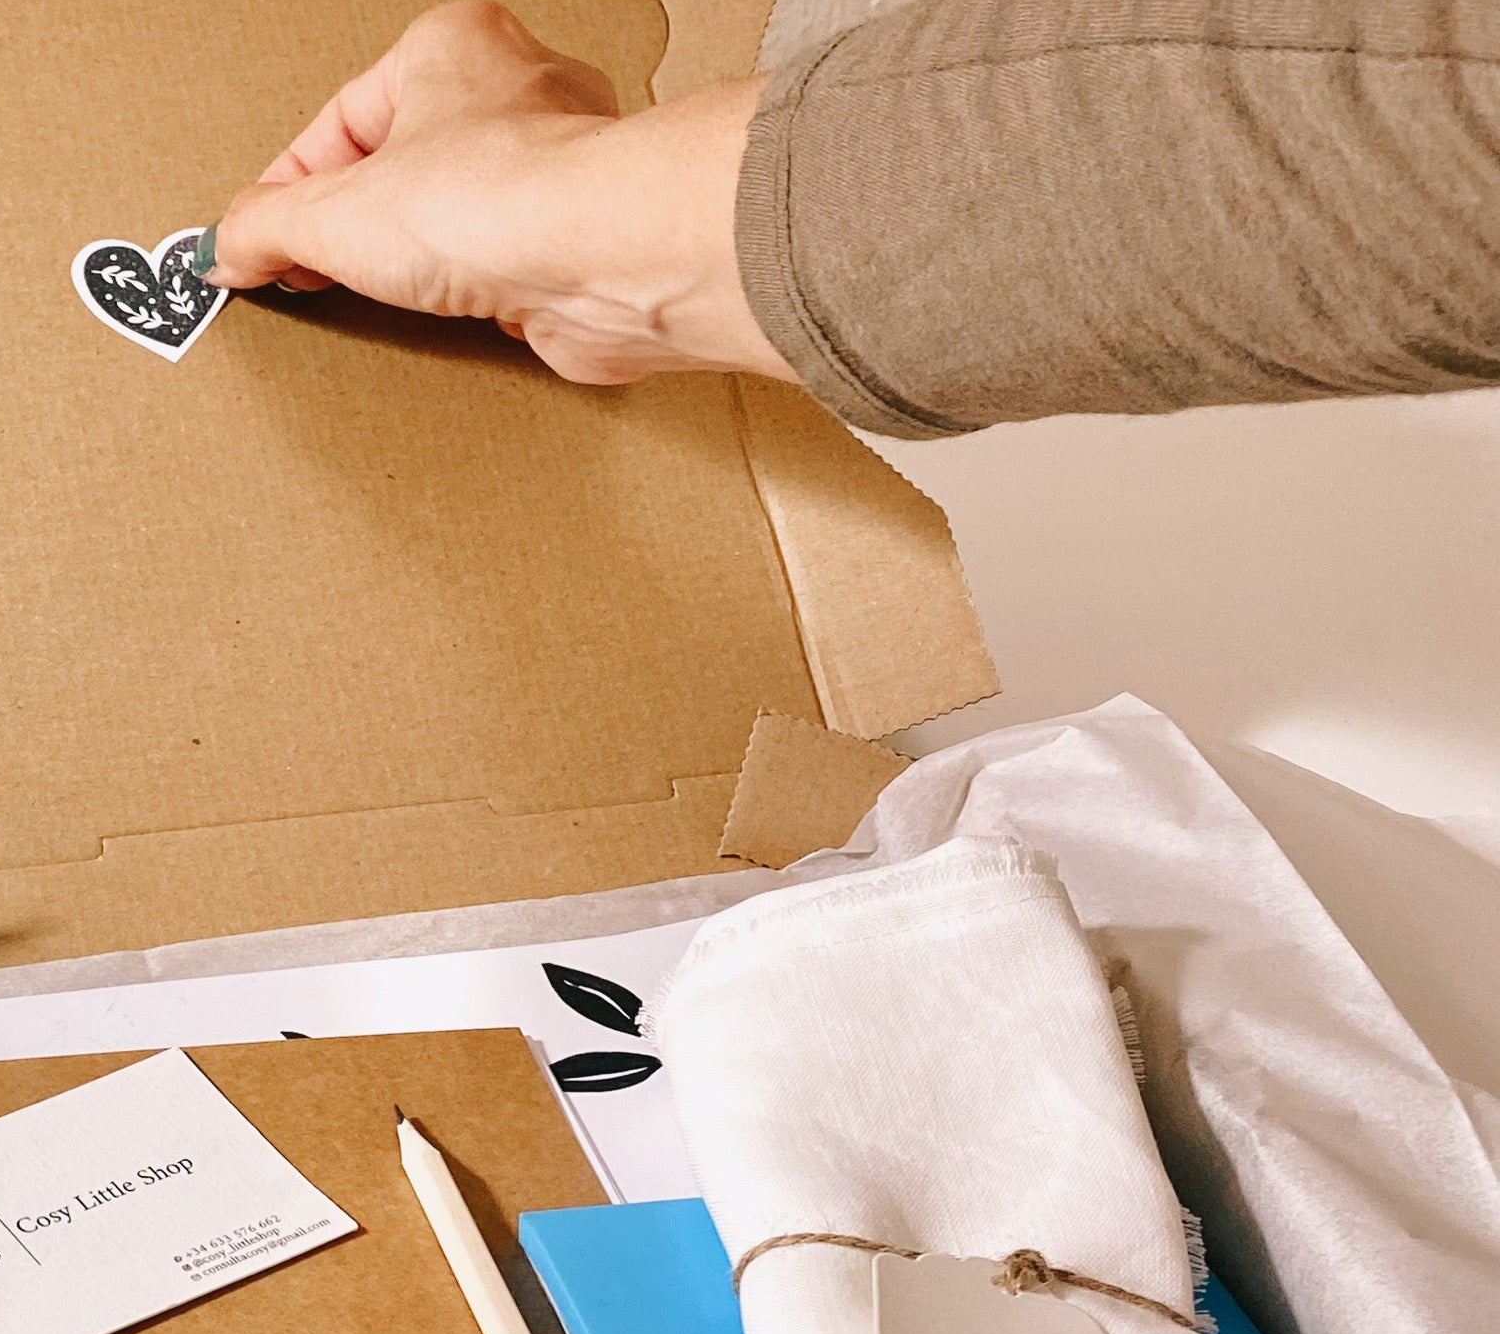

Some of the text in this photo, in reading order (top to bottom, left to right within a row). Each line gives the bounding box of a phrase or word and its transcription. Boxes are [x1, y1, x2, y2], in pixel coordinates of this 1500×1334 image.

[16, 1204, 73, 1234] Cosy
[74, 1180, 136, 1211] Little
[136, 1157, 194, 1186] Shop
[185, 1214, 282, 1259] +34 633 576 662
[202, 1217, 331, 1277] consultacosy@gmail.com
